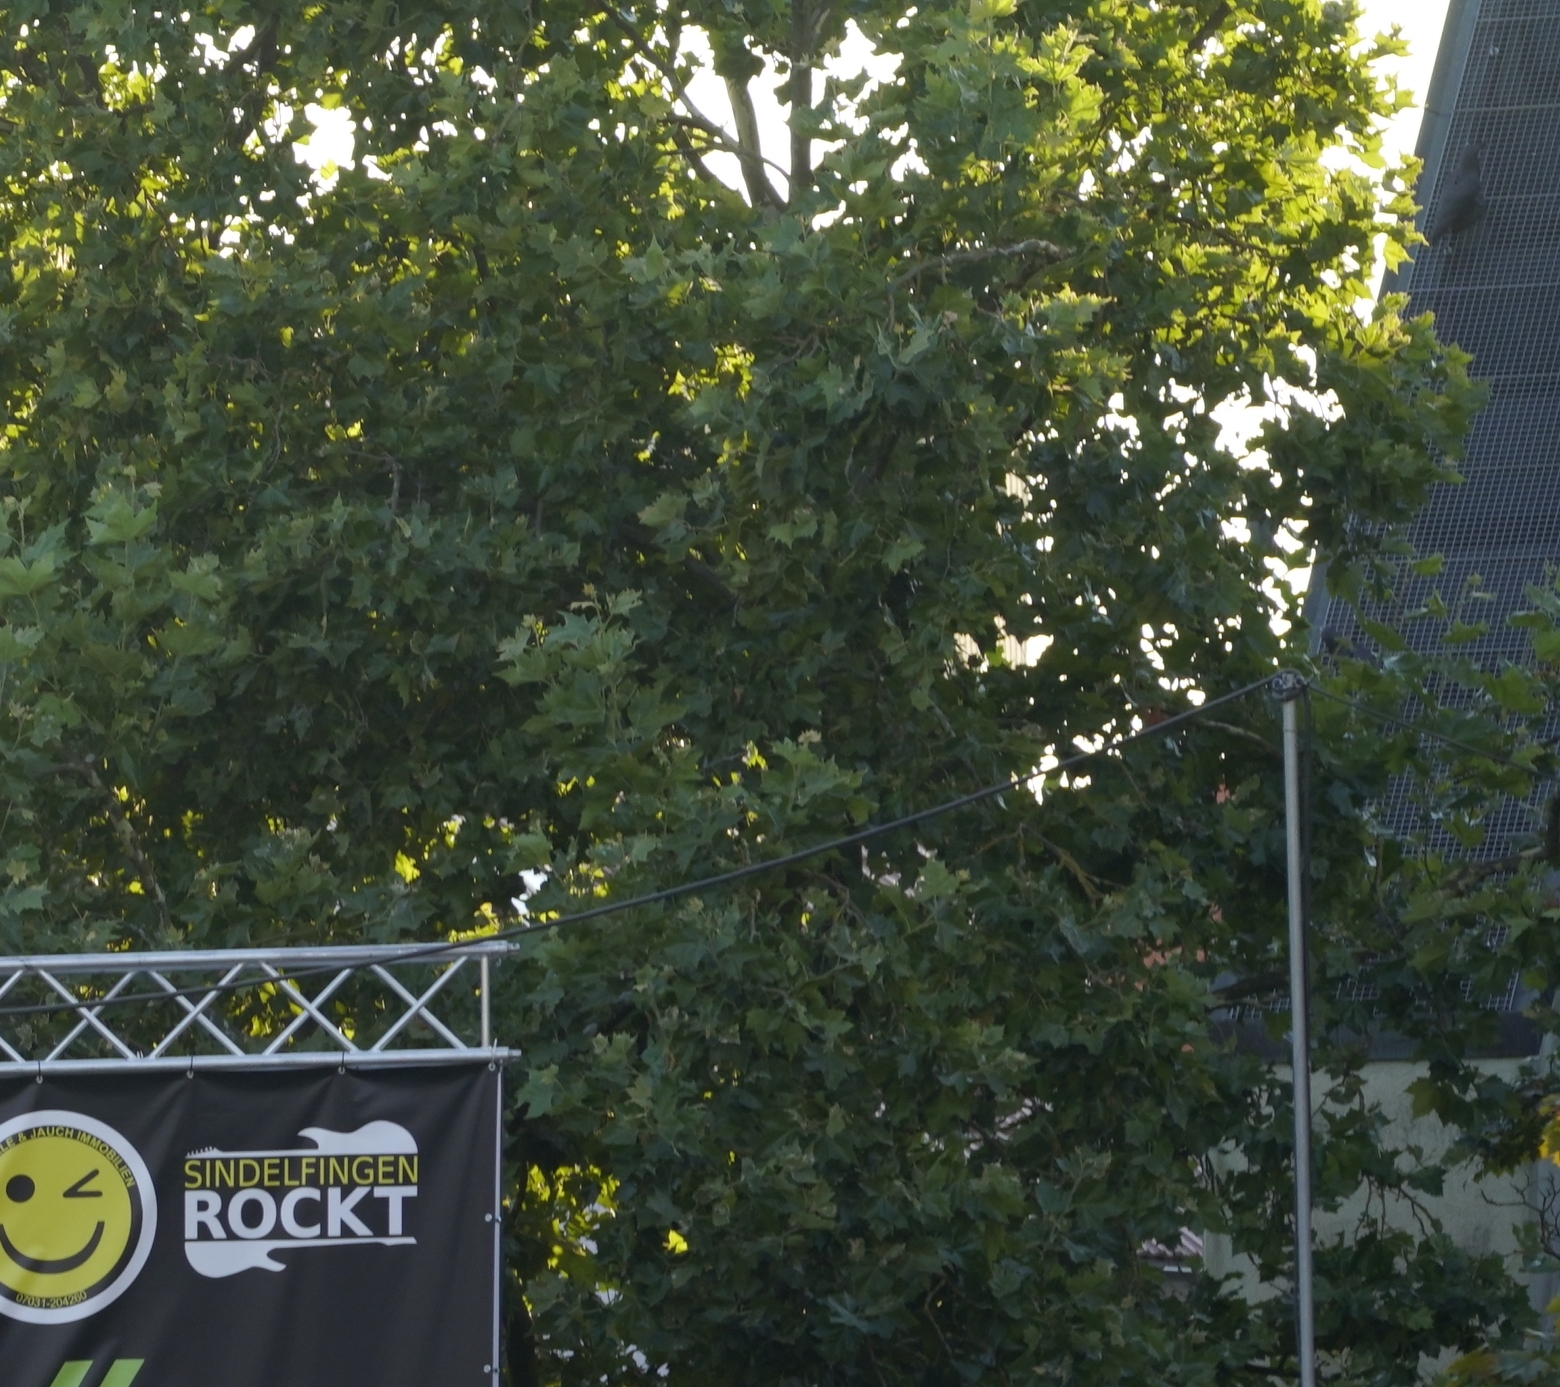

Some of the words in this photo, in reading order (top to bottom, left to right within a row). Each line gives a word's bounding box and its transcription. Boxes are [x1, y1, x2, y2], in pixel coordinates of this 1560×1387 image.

[18, 1132, 27, 1142] &
[30, 1126, 74, 1139] JAUCH
[76, 1130, 135, 1187] IMMOBILIEN
[184, 1155, 418, 1189] SINDELFINGEN
[184, 1186, 418, 1240] ROCKT
[16, 1290, 87, 1309] 07031-204260
